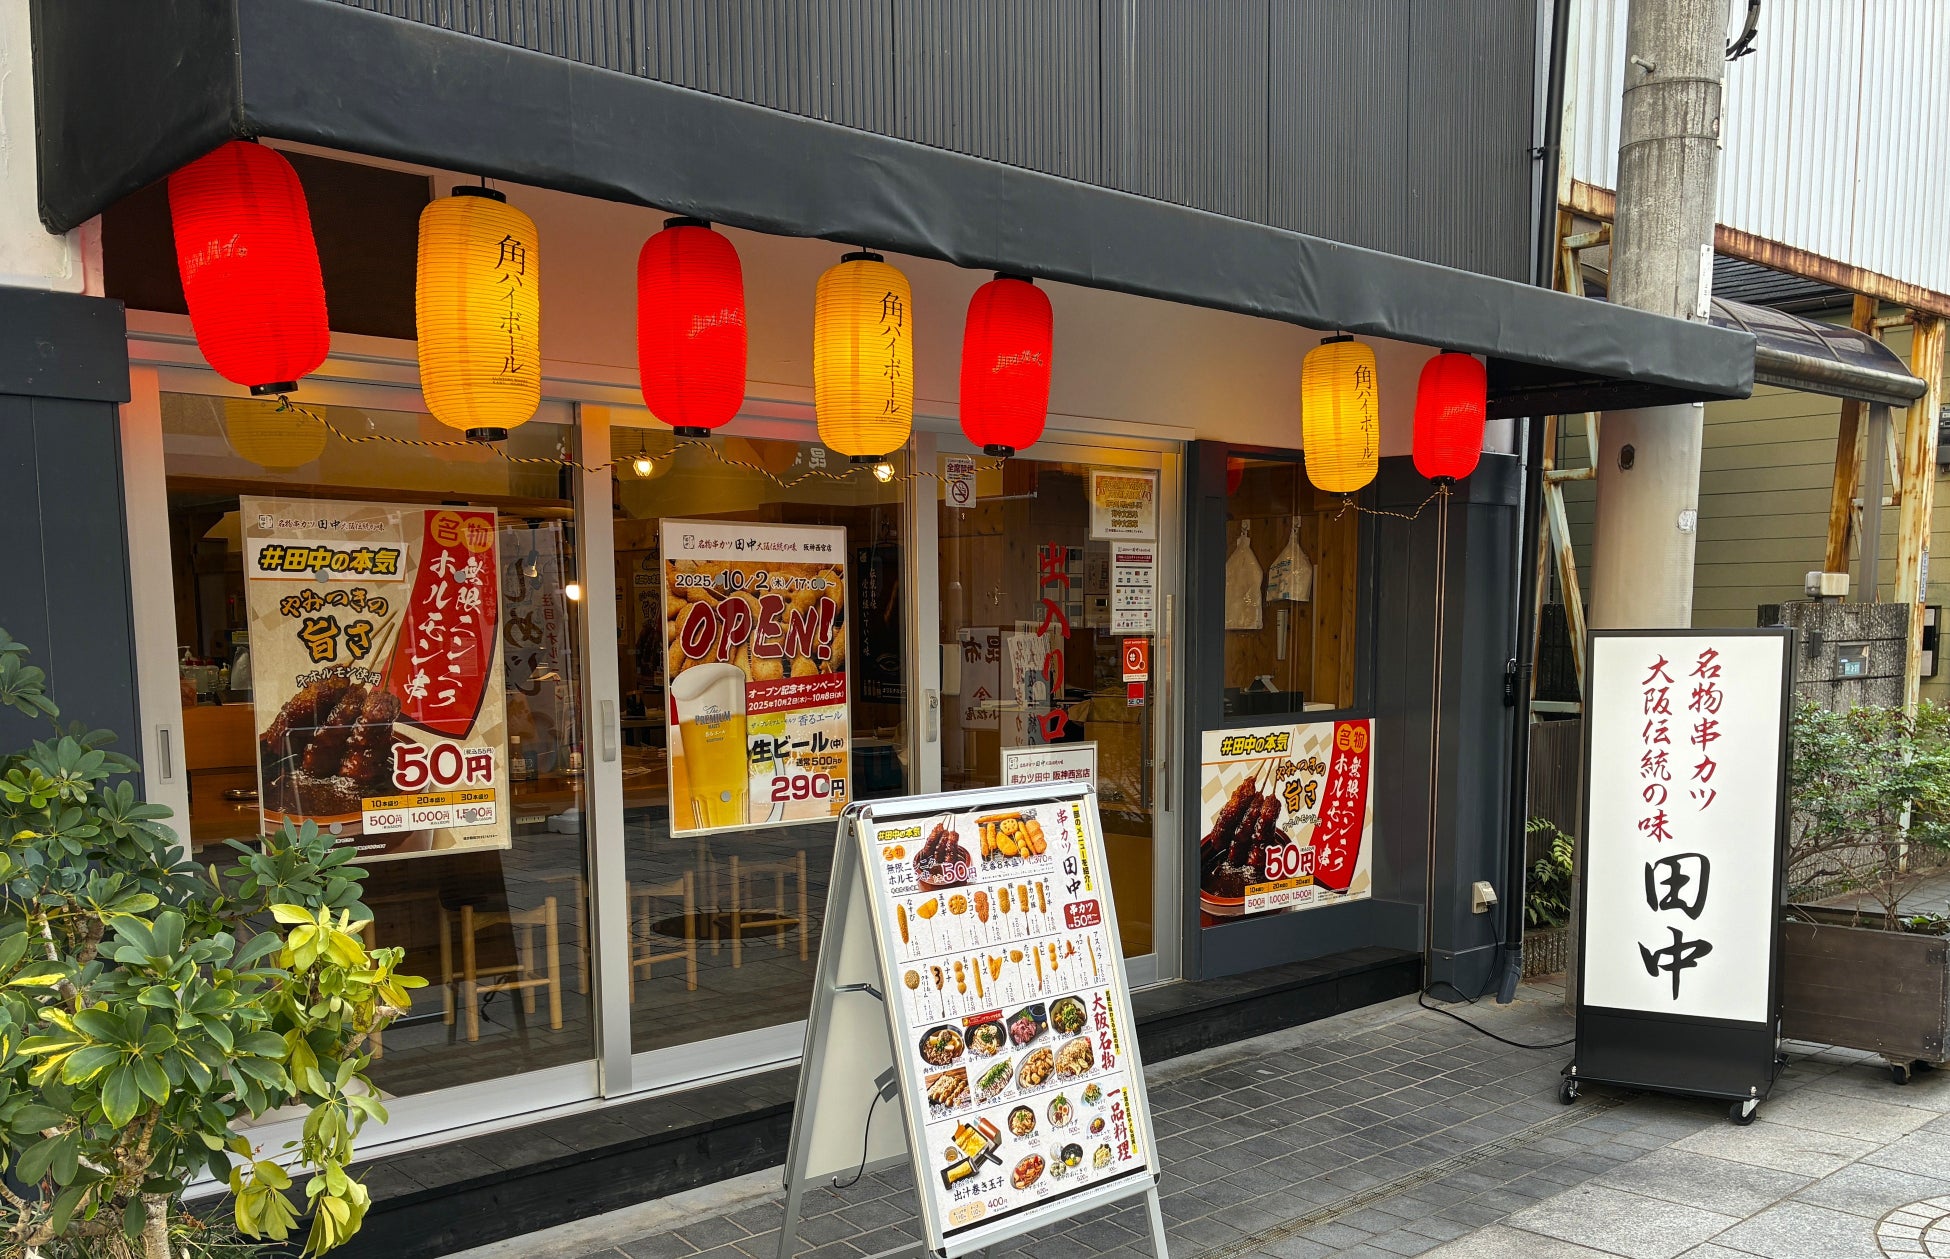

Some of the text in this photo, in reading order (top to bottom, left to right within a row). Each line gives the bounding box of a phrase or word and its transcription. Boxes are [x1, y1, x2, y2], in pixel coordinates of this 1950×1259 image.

[494, 234, 526, 377] 角ハイボール
[879, 291, 903, 416] 角ハイボール
[1353, 364, 1374, 462] 角ハイボール
[437, 517, 489, 548] 名物
[803, 543, 833, 552] 阪神西宮店
[258, 545, 399, 576] #田中の本気
[280, 588, 389, 617] やみつきの
[296, 614, 374, 664] 旨さ
[403, 549, 457, 704] ホルモン串
[679, 593, 836, 663] OPEN!
[1037, 541, 1071, 743] 出入り口
[748, 680, 844, 698] オープン記念キャンペーン
[694, 710, 732, 726] PREMIUM
[798, 711, 843, 727] 香るエール
[1688, 646, 1724, 811] 名物串カツ
[1220, 732, 1290, 756] #田中の本気
[1638, 653, 1675, 843] 大阪伝統の味
[391, 741, 495, 791] 50円
[1011, 768, 1091, 784] 串カツ田中 阪神西宮店
[1276, 756, 1327, 781] やみつきの
[460, 793, 489, 801] 30本盛り
[770, 773, 845, 803] 290円
[1282, 778, 1319, 814] 旨さ
[369, 814, 403, 827] 500円
[411, 810, 450, 824] 1,000円
[1317, 752, 1348, 871] ホルモン串
[1265, 842, 1316, 881] 50円
[907, 898, 915, 922] なすび
[966, 889, 975, 919] レンコン
[1069, 902, 1094, 915] 串カツ
[1638, 852, 1713, 1001] 田中
[1039, 941, 1045, 956] エビ
[1093, 931, 1102, 959] アスパラ
[943, 958, 952, 982] バナナ
[963, 956, 969, 970] もち
[979, 952, 988, 975] チーズ
[1092, 991, 1116, 1071] 大阪名物
[1106, 1088, 1132, 1162] 一品料理
[953, 1175, 1005, 1202] 出汁巻き玉子
